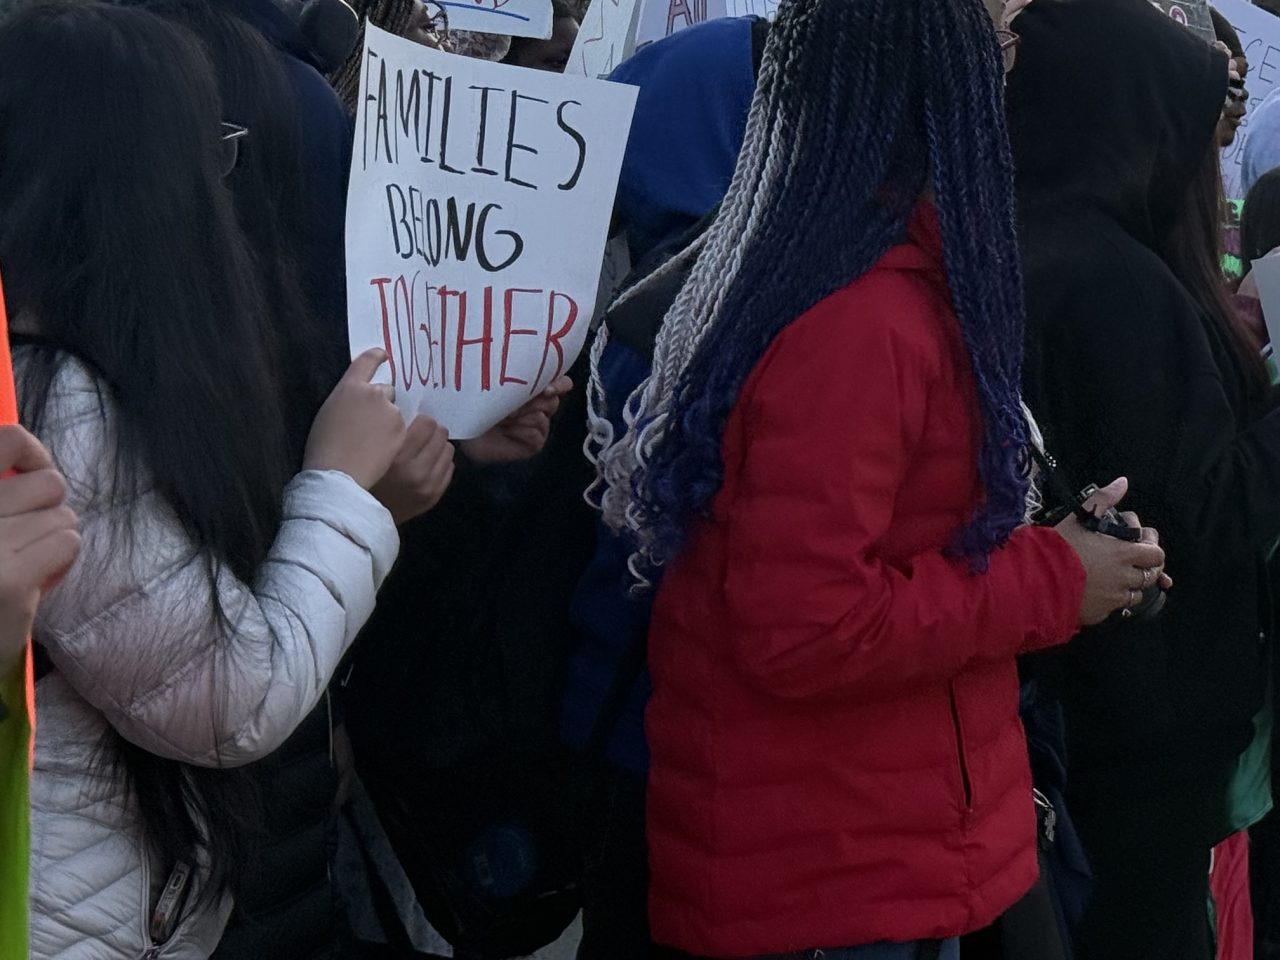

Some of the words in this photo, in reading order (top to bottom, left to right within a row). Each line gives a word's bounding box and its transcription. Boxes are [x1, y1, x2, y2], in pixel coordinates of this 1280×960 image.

[362, 46, 587, 191] FAMILIES
[386, 183, 524, 273] BELONG
[370, 270, 579, 396] TOGETHER
